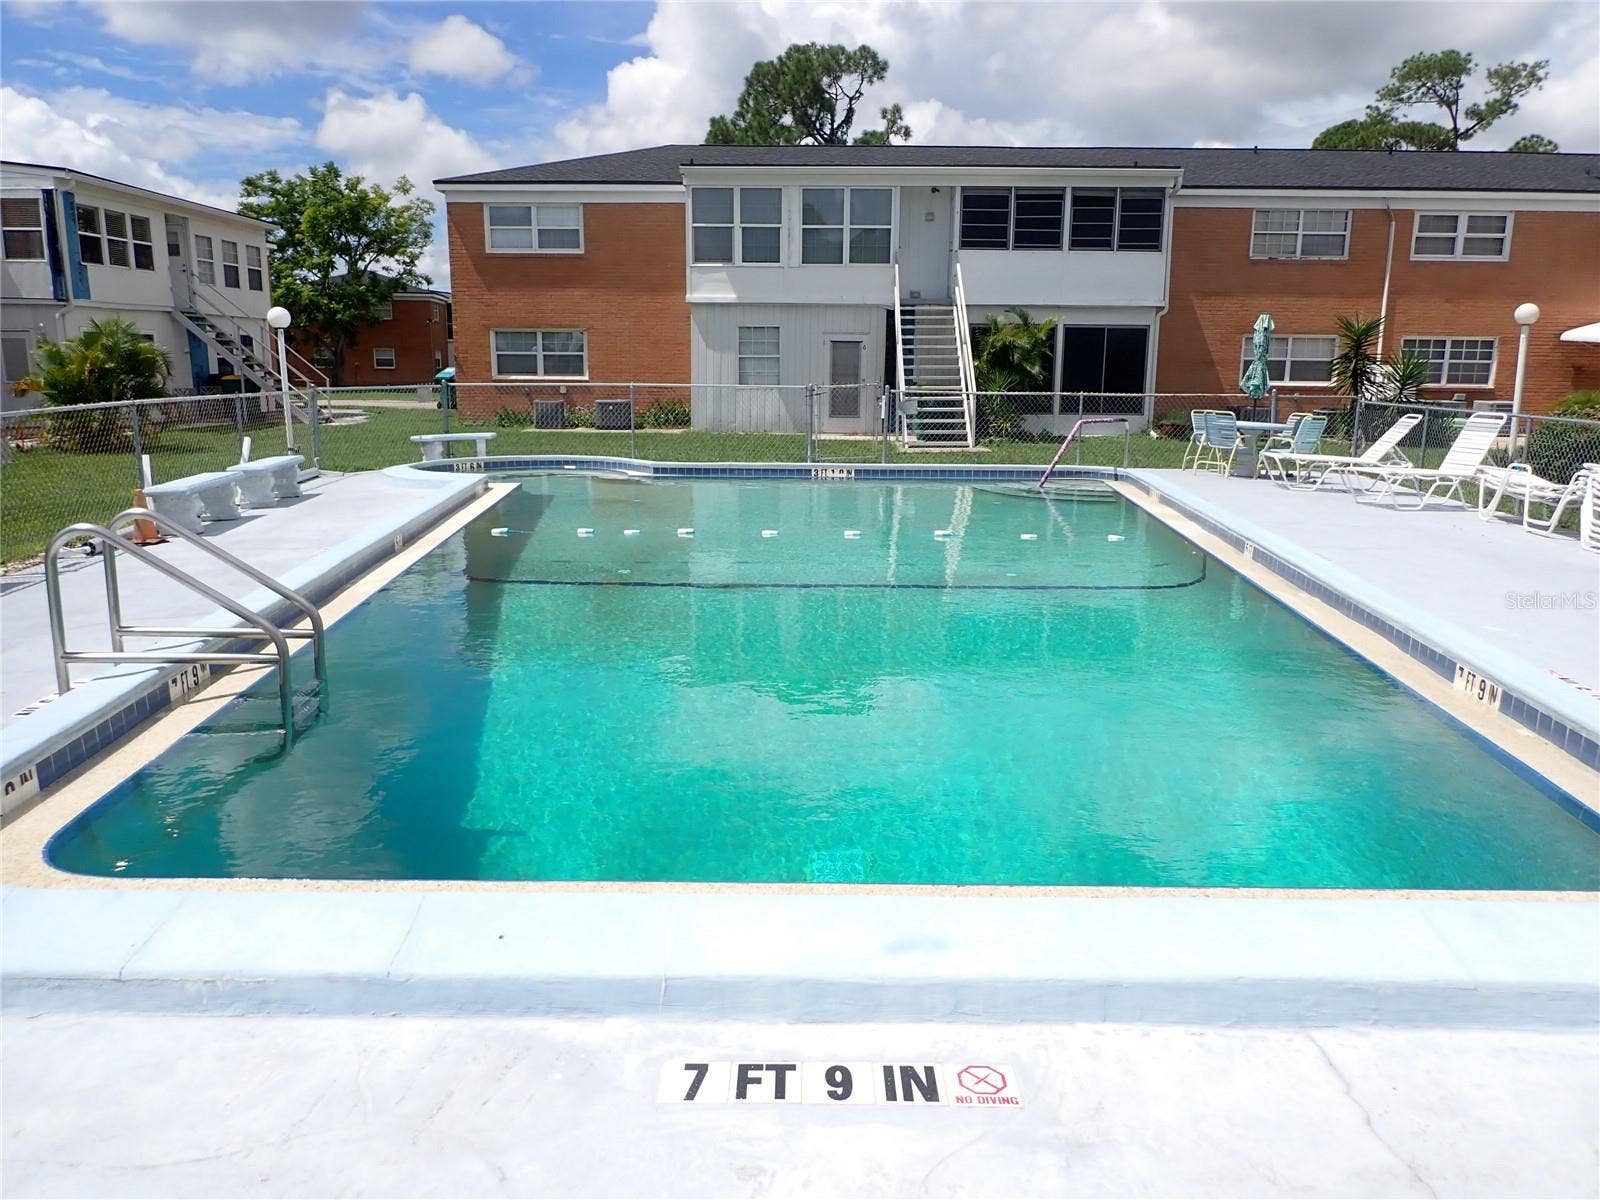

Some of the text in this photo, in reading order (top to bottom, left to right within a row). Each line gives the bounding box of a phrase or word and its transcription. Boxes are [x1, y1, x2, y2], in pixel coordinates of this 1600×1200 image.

[813, 468, 819, 477] 3
[192, 664, 200, 686] 9
[1464, 670, 1477, 692] FT
[1477, 679, 1487, 701] 9
[1488, 683, 1499, 706] IN
[683, 1063, 940, 1102] 7 FT 9 IN
[955, 1095, 1019, 1105] NO DIVING
